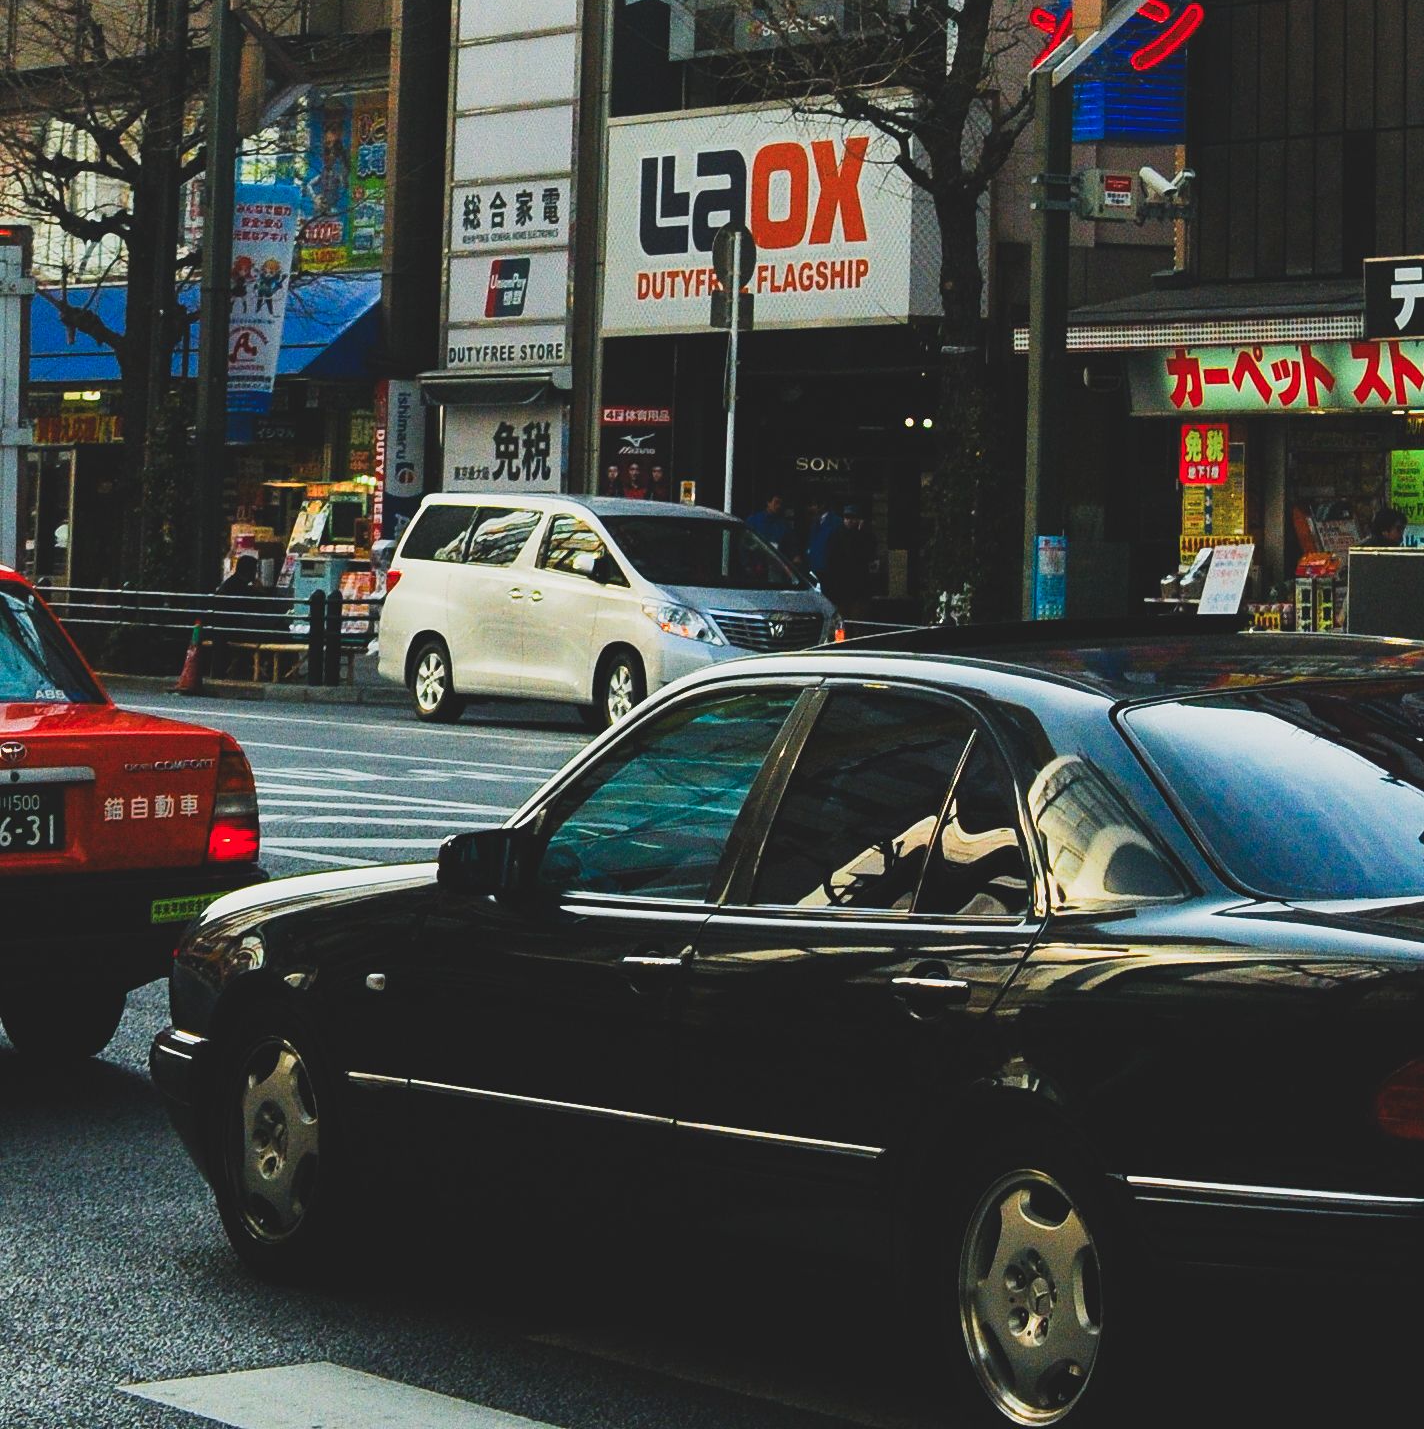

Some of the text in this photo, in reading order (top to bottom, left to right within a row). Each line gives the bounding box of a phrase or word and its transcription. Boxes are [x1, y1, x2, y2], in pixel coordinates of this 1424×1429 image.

[462, 186, 561, 231] 総合家電
[636, 257, 870, 301] DUTYFR FLAGSHIP
[448, 342, 564, 364] DUTYFREE STORE
[1166, 339, 1336, 410] カーペット
[492, 420, 551, 481] 免税
